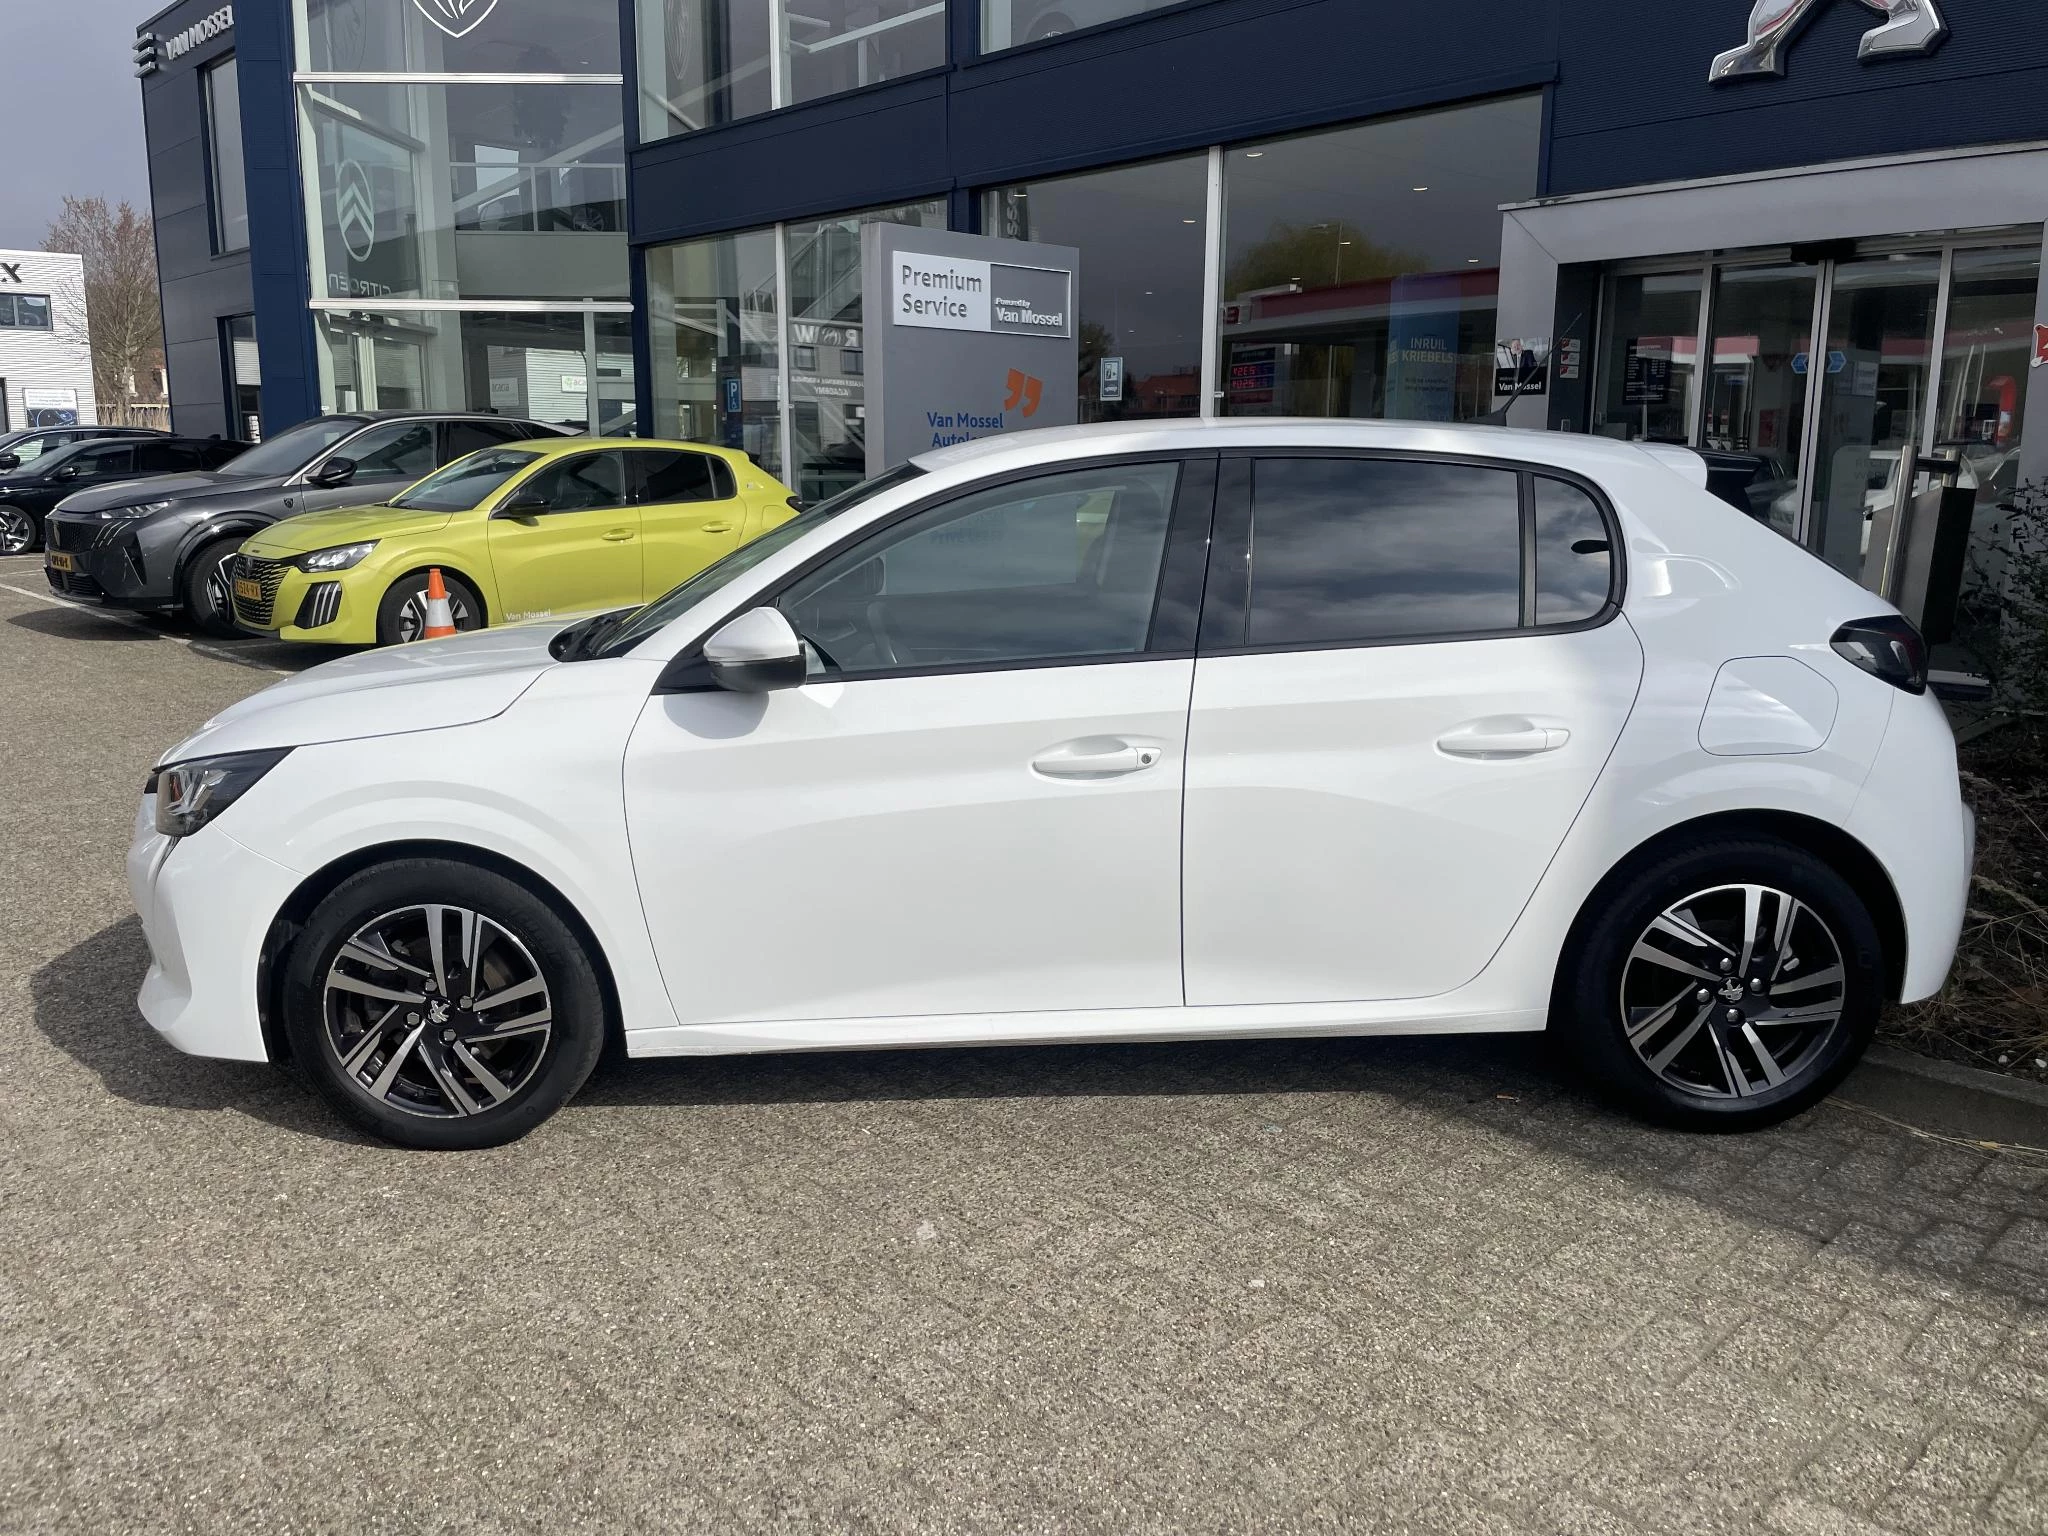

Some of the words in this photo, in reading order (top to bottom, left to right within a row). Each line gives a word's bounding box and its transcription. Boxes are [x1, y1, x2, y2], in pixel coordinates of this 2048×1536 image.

[166, 31, 189, 60] VAN
[188, 5, 234, 48] MOSSEL
[902, 264, 982, 293] Premium
[902, 293, 968, 318] Service
[996, 297, 1021, 306] Powered
[1021, 299, 1030, 309] by
[997, 307, 1019, 323] Van
[1021, 310, 1063, 326] Mossel
[1410, 337, 1447, 350] INRUIL
[730, 382, 738, 397] P
[1499, 383, 1513, 391] Van
[927, 411, 953, 427] Van
[957, 412, 1004, 428] Mossel
[506, 612, 521, 621] Van
[523, 608, 551, 620] Mossel
